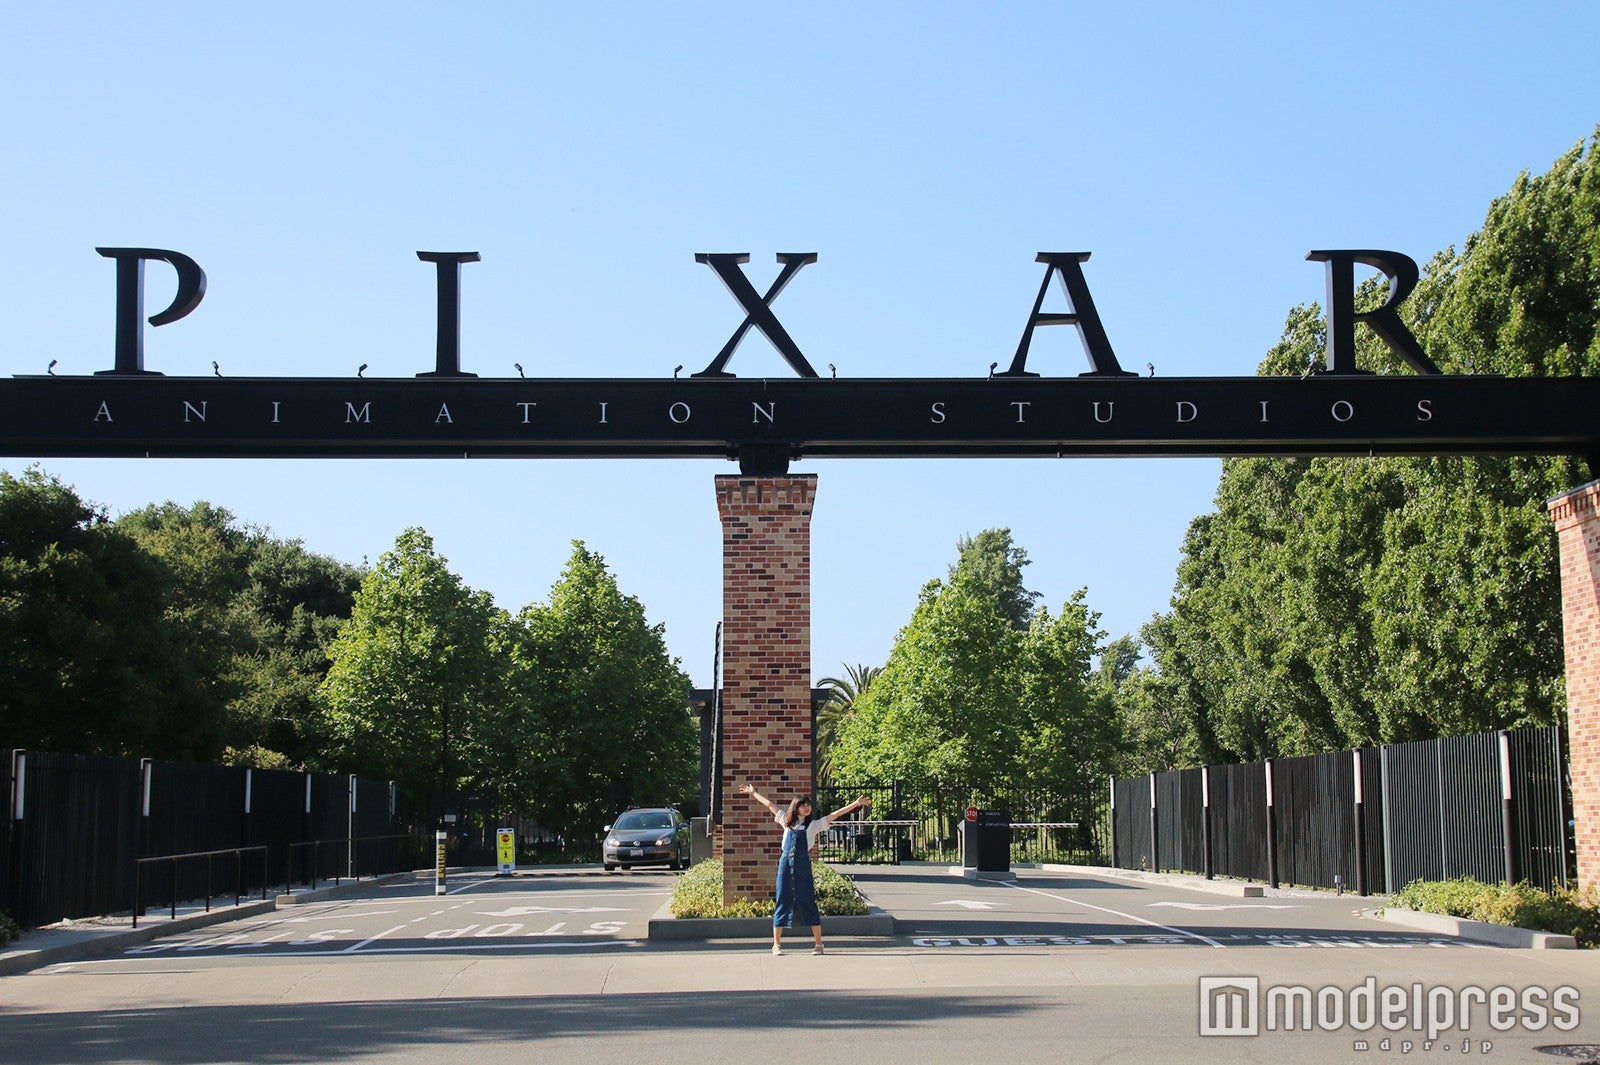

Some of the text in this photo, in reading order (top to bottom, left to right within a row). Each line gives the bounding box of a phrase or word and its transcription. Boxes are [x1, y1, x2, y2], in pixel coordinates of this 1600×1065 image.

[94, 247, 1438, 379] PIXAR
[93, 400, 1434, 425] ANIMATION STUDIOS
